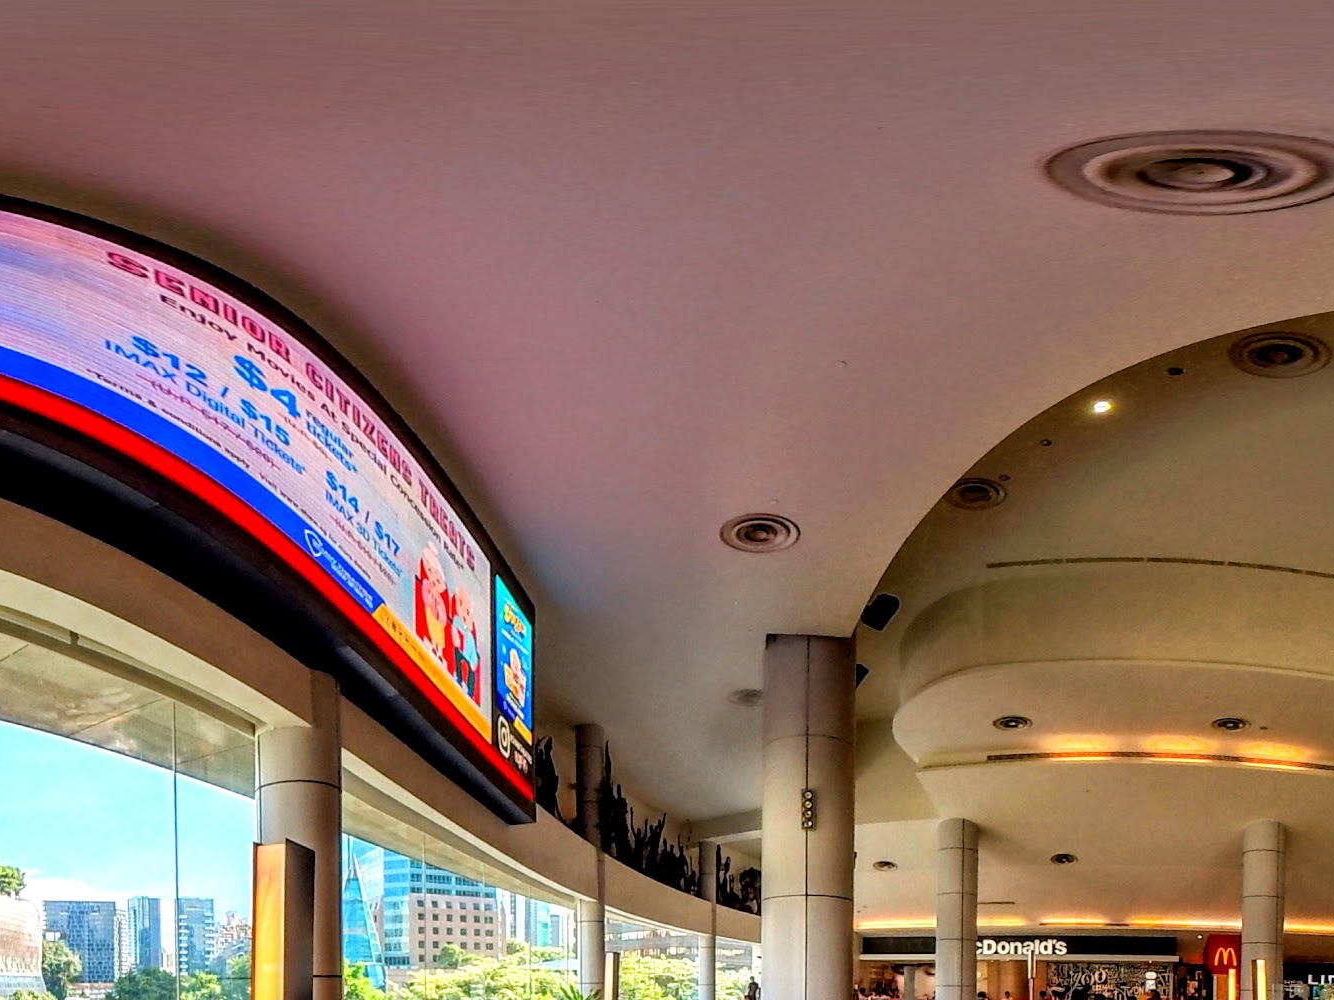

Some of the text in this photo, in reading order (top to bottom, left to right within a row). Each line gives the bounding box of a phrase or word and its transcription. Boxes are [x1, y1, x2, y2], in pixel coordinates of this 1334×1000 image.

[105, 340, 176, 383] IMAX
[186, 381, 244, 427] Digital
[107, 252, 474, 570] SENIOR CITIZENS TREATS
[132, 336, 206, 386] $12
[240, 399, 289, 445] $15
[159, 294, 236, 340] Enjoy
[247, 342, 315, 401] Movies
[320, 402, 337, 422] At
[341, 421, 386, 474] Special
[390, 474, 440, 542] Concession
[234, 355, 299, 416] $4
[306, 409, 352, 457] regular
[325, 490, 353, 525] IMAX
[356, 521, 370, 541] 3D
[326, 471, 358, 512] $14
[374, 521, 399, 555] $17
[976, 938, 1067, 956] cDonald's
